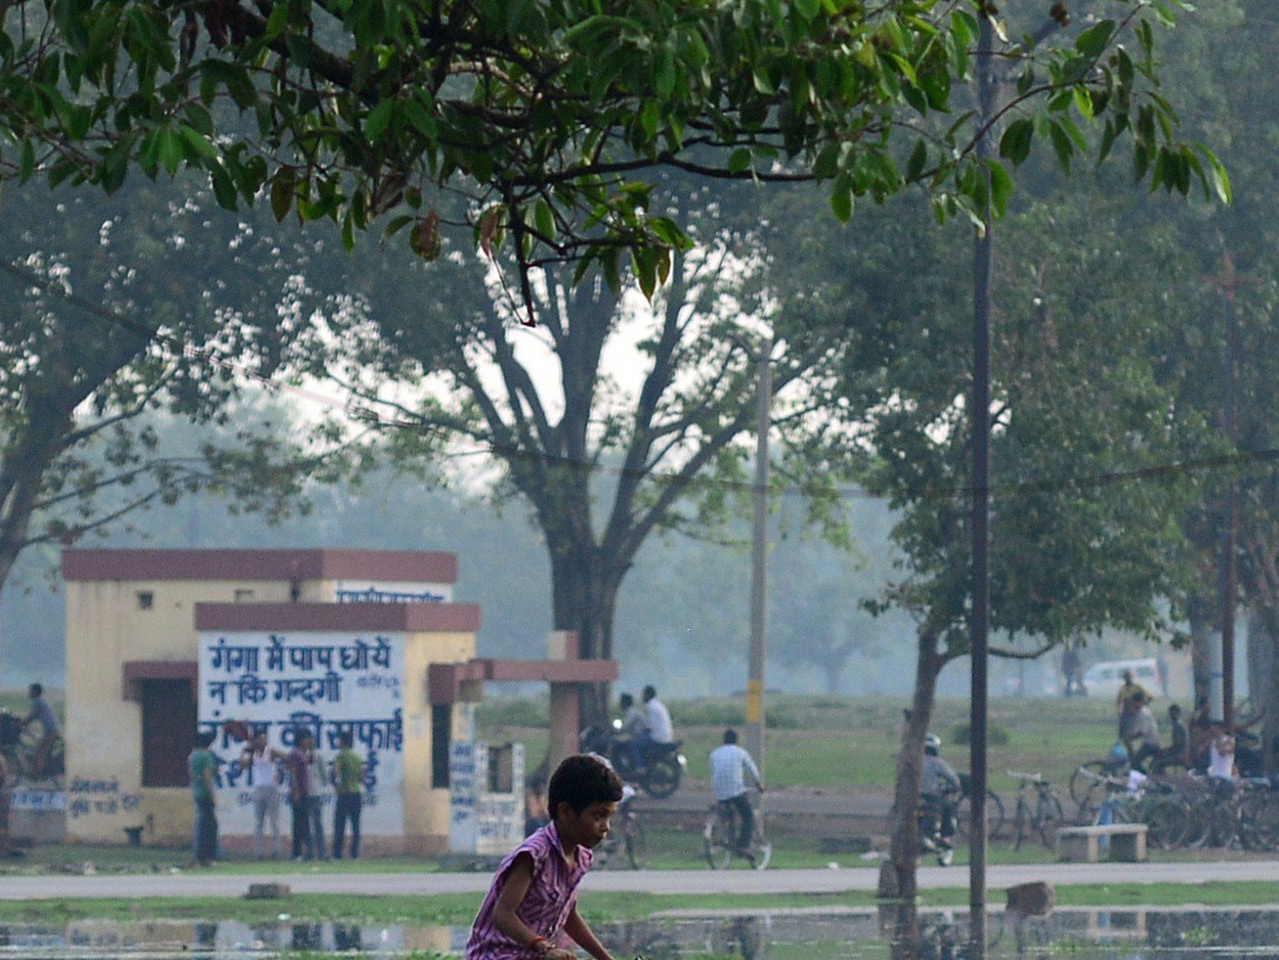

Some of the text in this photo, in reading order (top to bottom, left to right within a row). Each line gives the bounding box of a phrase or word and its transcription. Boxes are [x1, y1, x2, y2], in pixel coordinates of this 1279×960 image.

[208, 637, 259, 672] गंगा
[264, 635, 285, 671] में
[288, 645, 334, 671] पाप
[208, 680, 227, 705] न
[229, 674, 269, 705] कि
[272, 671, 343, 705] गन्दगी
